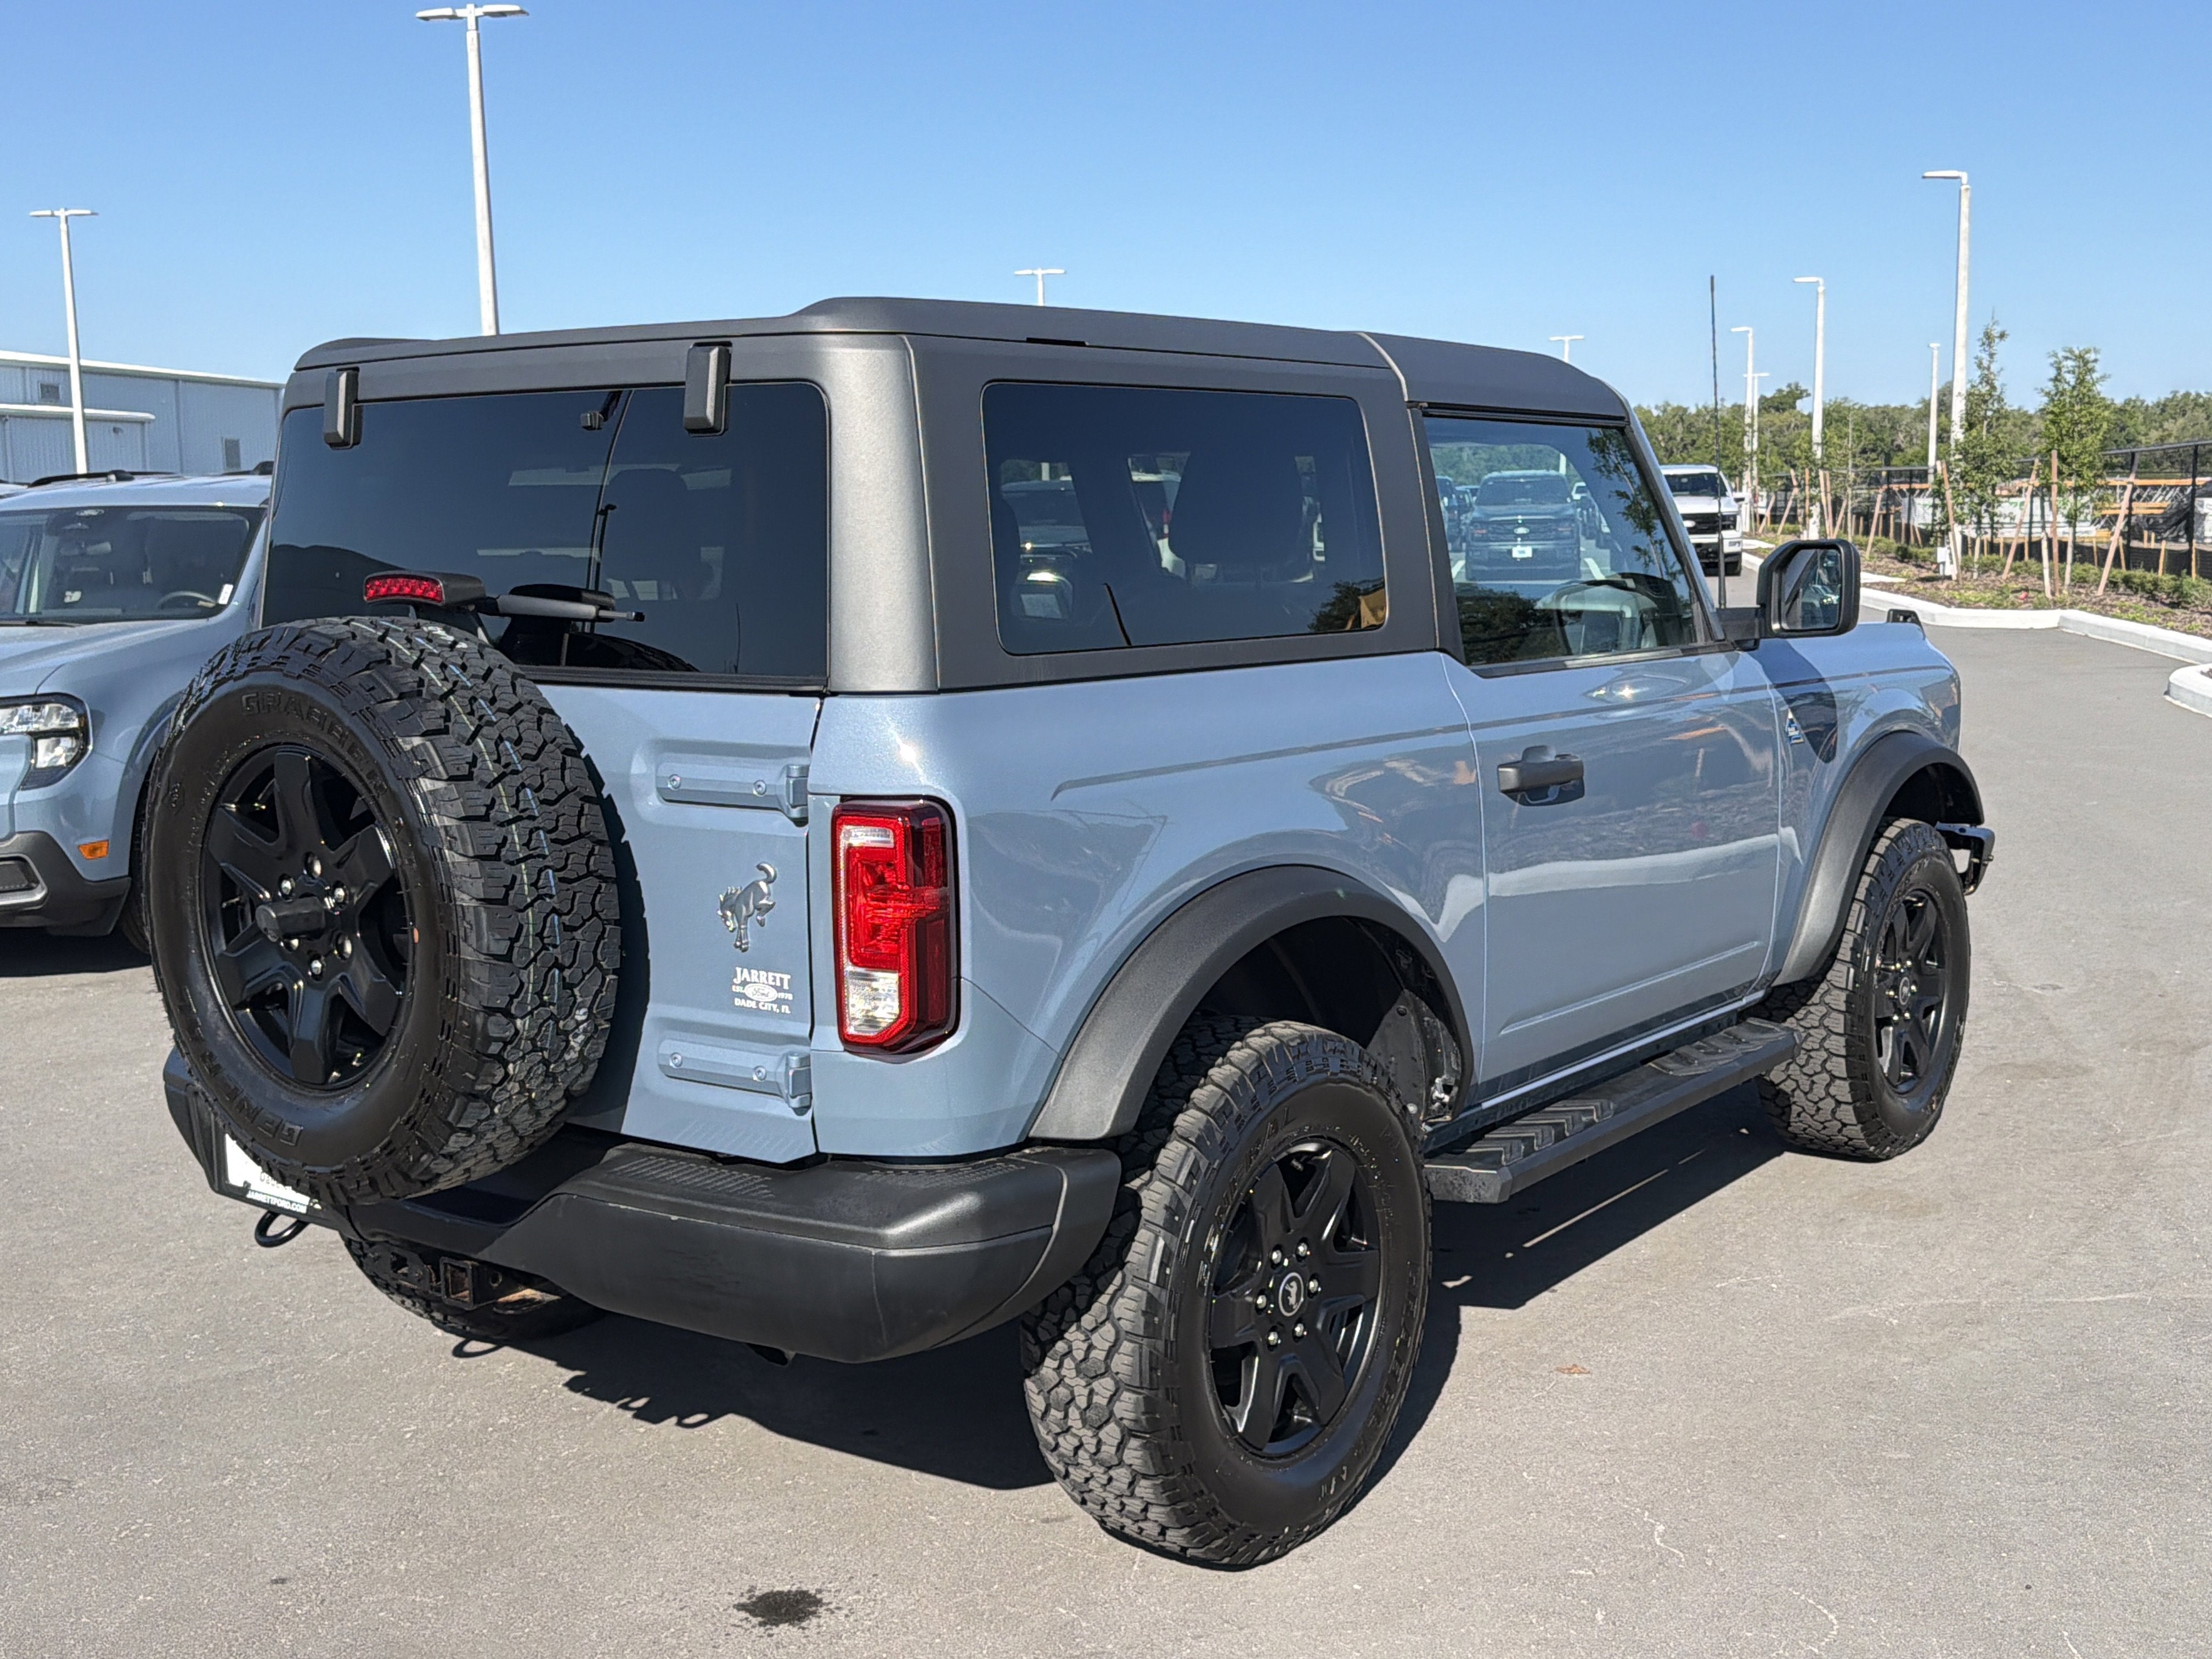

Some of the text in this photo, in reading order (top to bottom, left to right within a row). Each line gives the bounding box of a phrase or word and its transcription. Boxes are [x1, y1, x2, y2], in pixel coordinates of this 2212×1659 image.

[733, 967, 791, 990] JARRETT
[735, 997, 791, 1014] DADE CITY, FL
